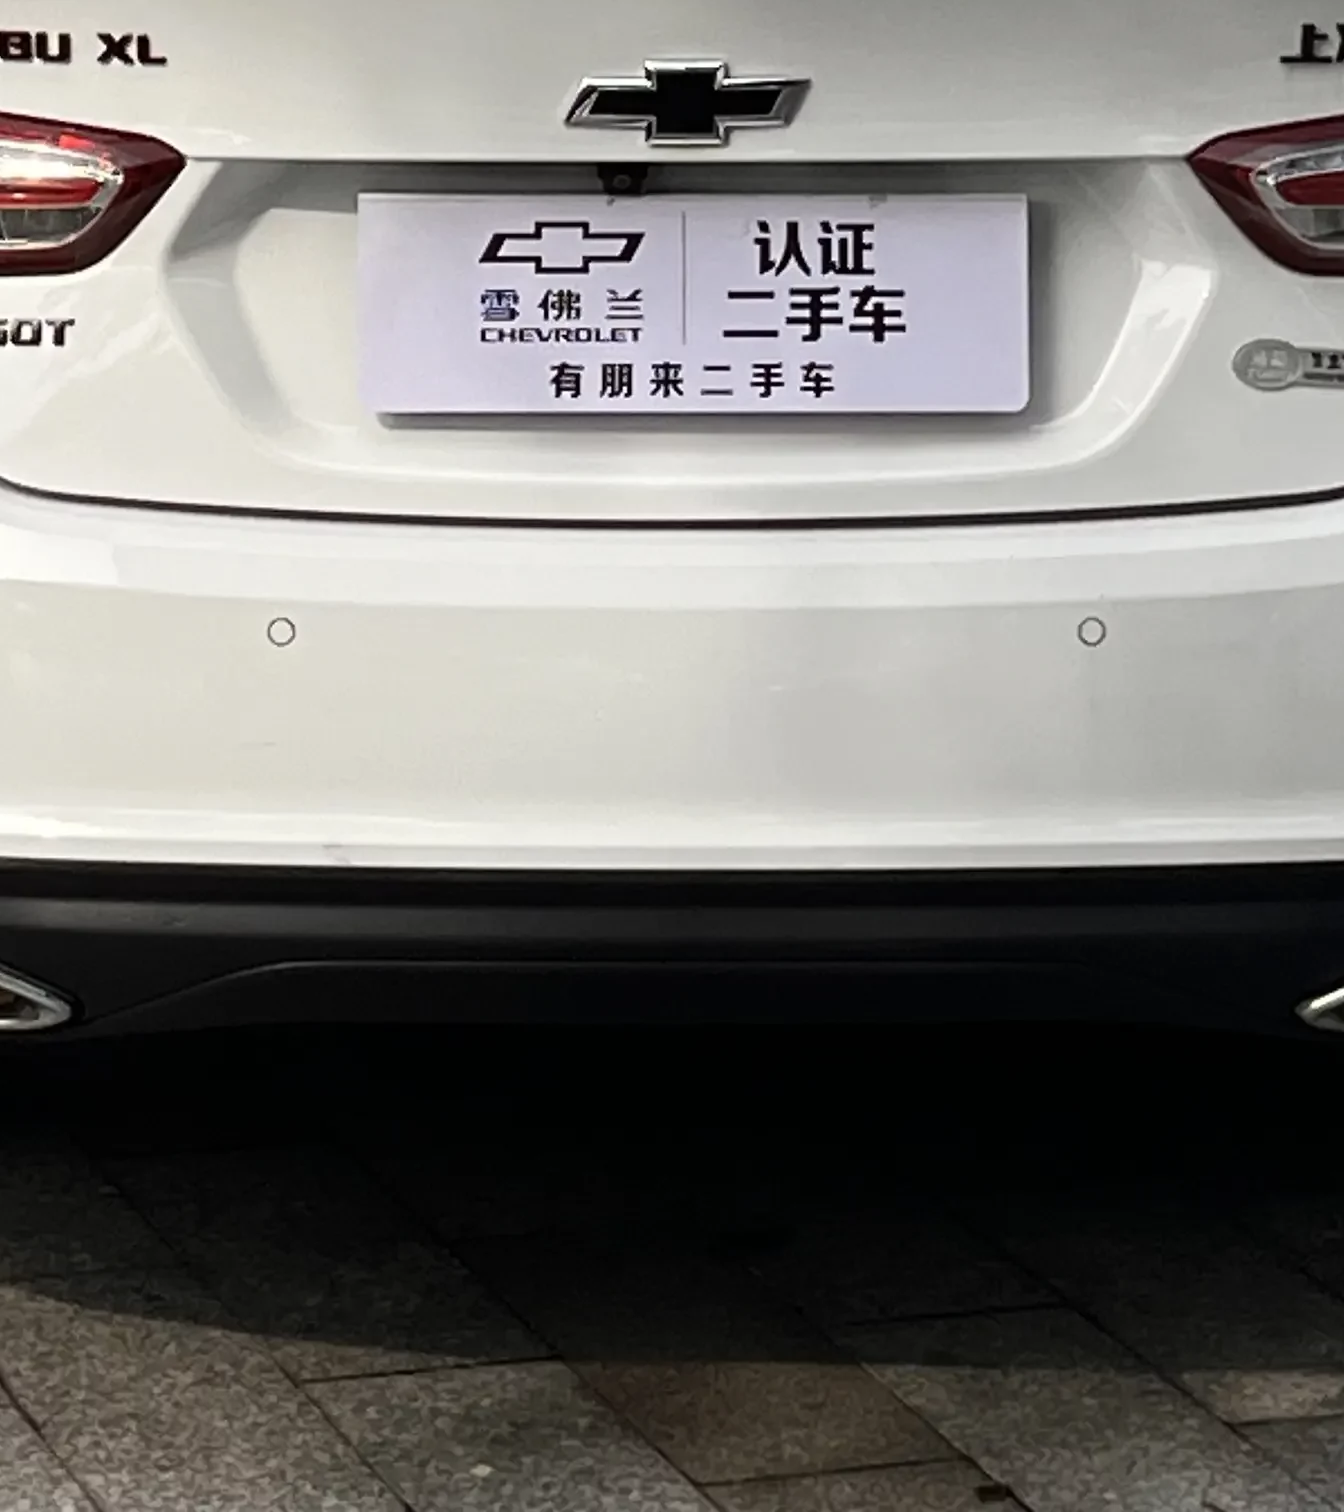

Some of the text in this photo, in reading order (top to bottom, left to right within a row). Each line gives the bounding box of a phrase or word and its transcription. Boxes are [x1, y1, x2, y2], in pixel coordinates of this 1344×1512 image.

[97, 33, 167, 65] XL
[753, 220, 876, 277] 认证
[480, 288, 645, 322] 雪佛兰
[722, 285, 907, 343] 二手车
[480, 327, 644, 343] CHEVROLET
[549, 360, 835, 398] 有朋来二手车
